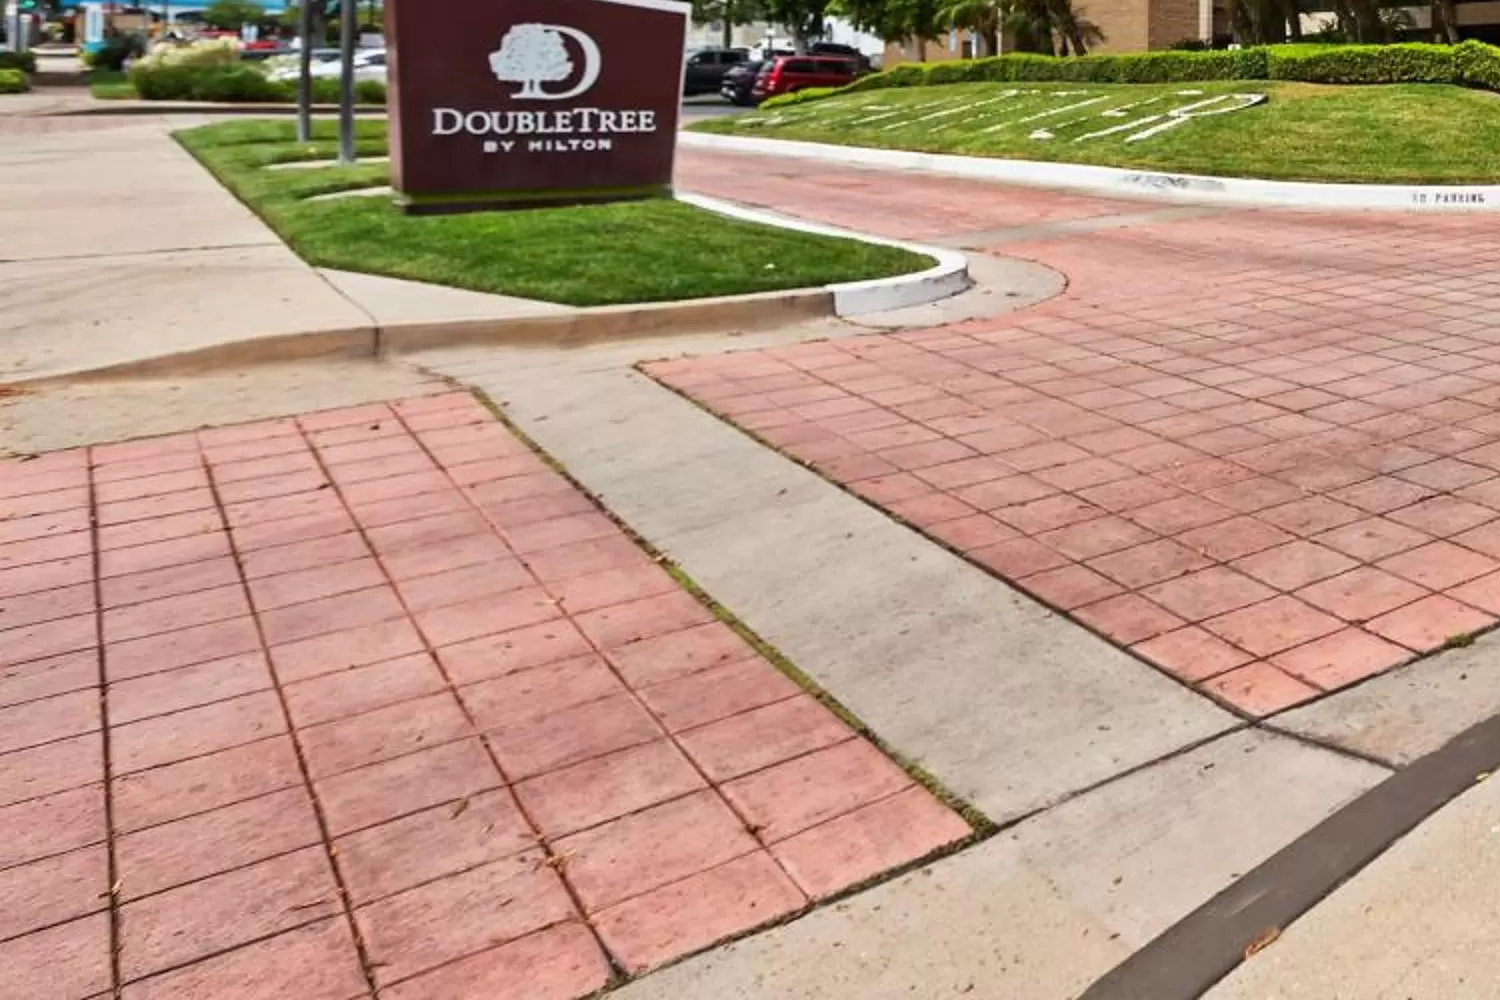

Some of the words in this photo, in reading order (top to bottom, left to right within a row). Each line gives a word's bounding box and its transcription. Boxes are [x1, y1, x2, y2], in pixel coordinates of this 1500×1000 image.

[432, 107, 656, 135] DOUBLETREE
[483, 140, 514, 152] BY
[528, 139, 612, 151] HILTON
